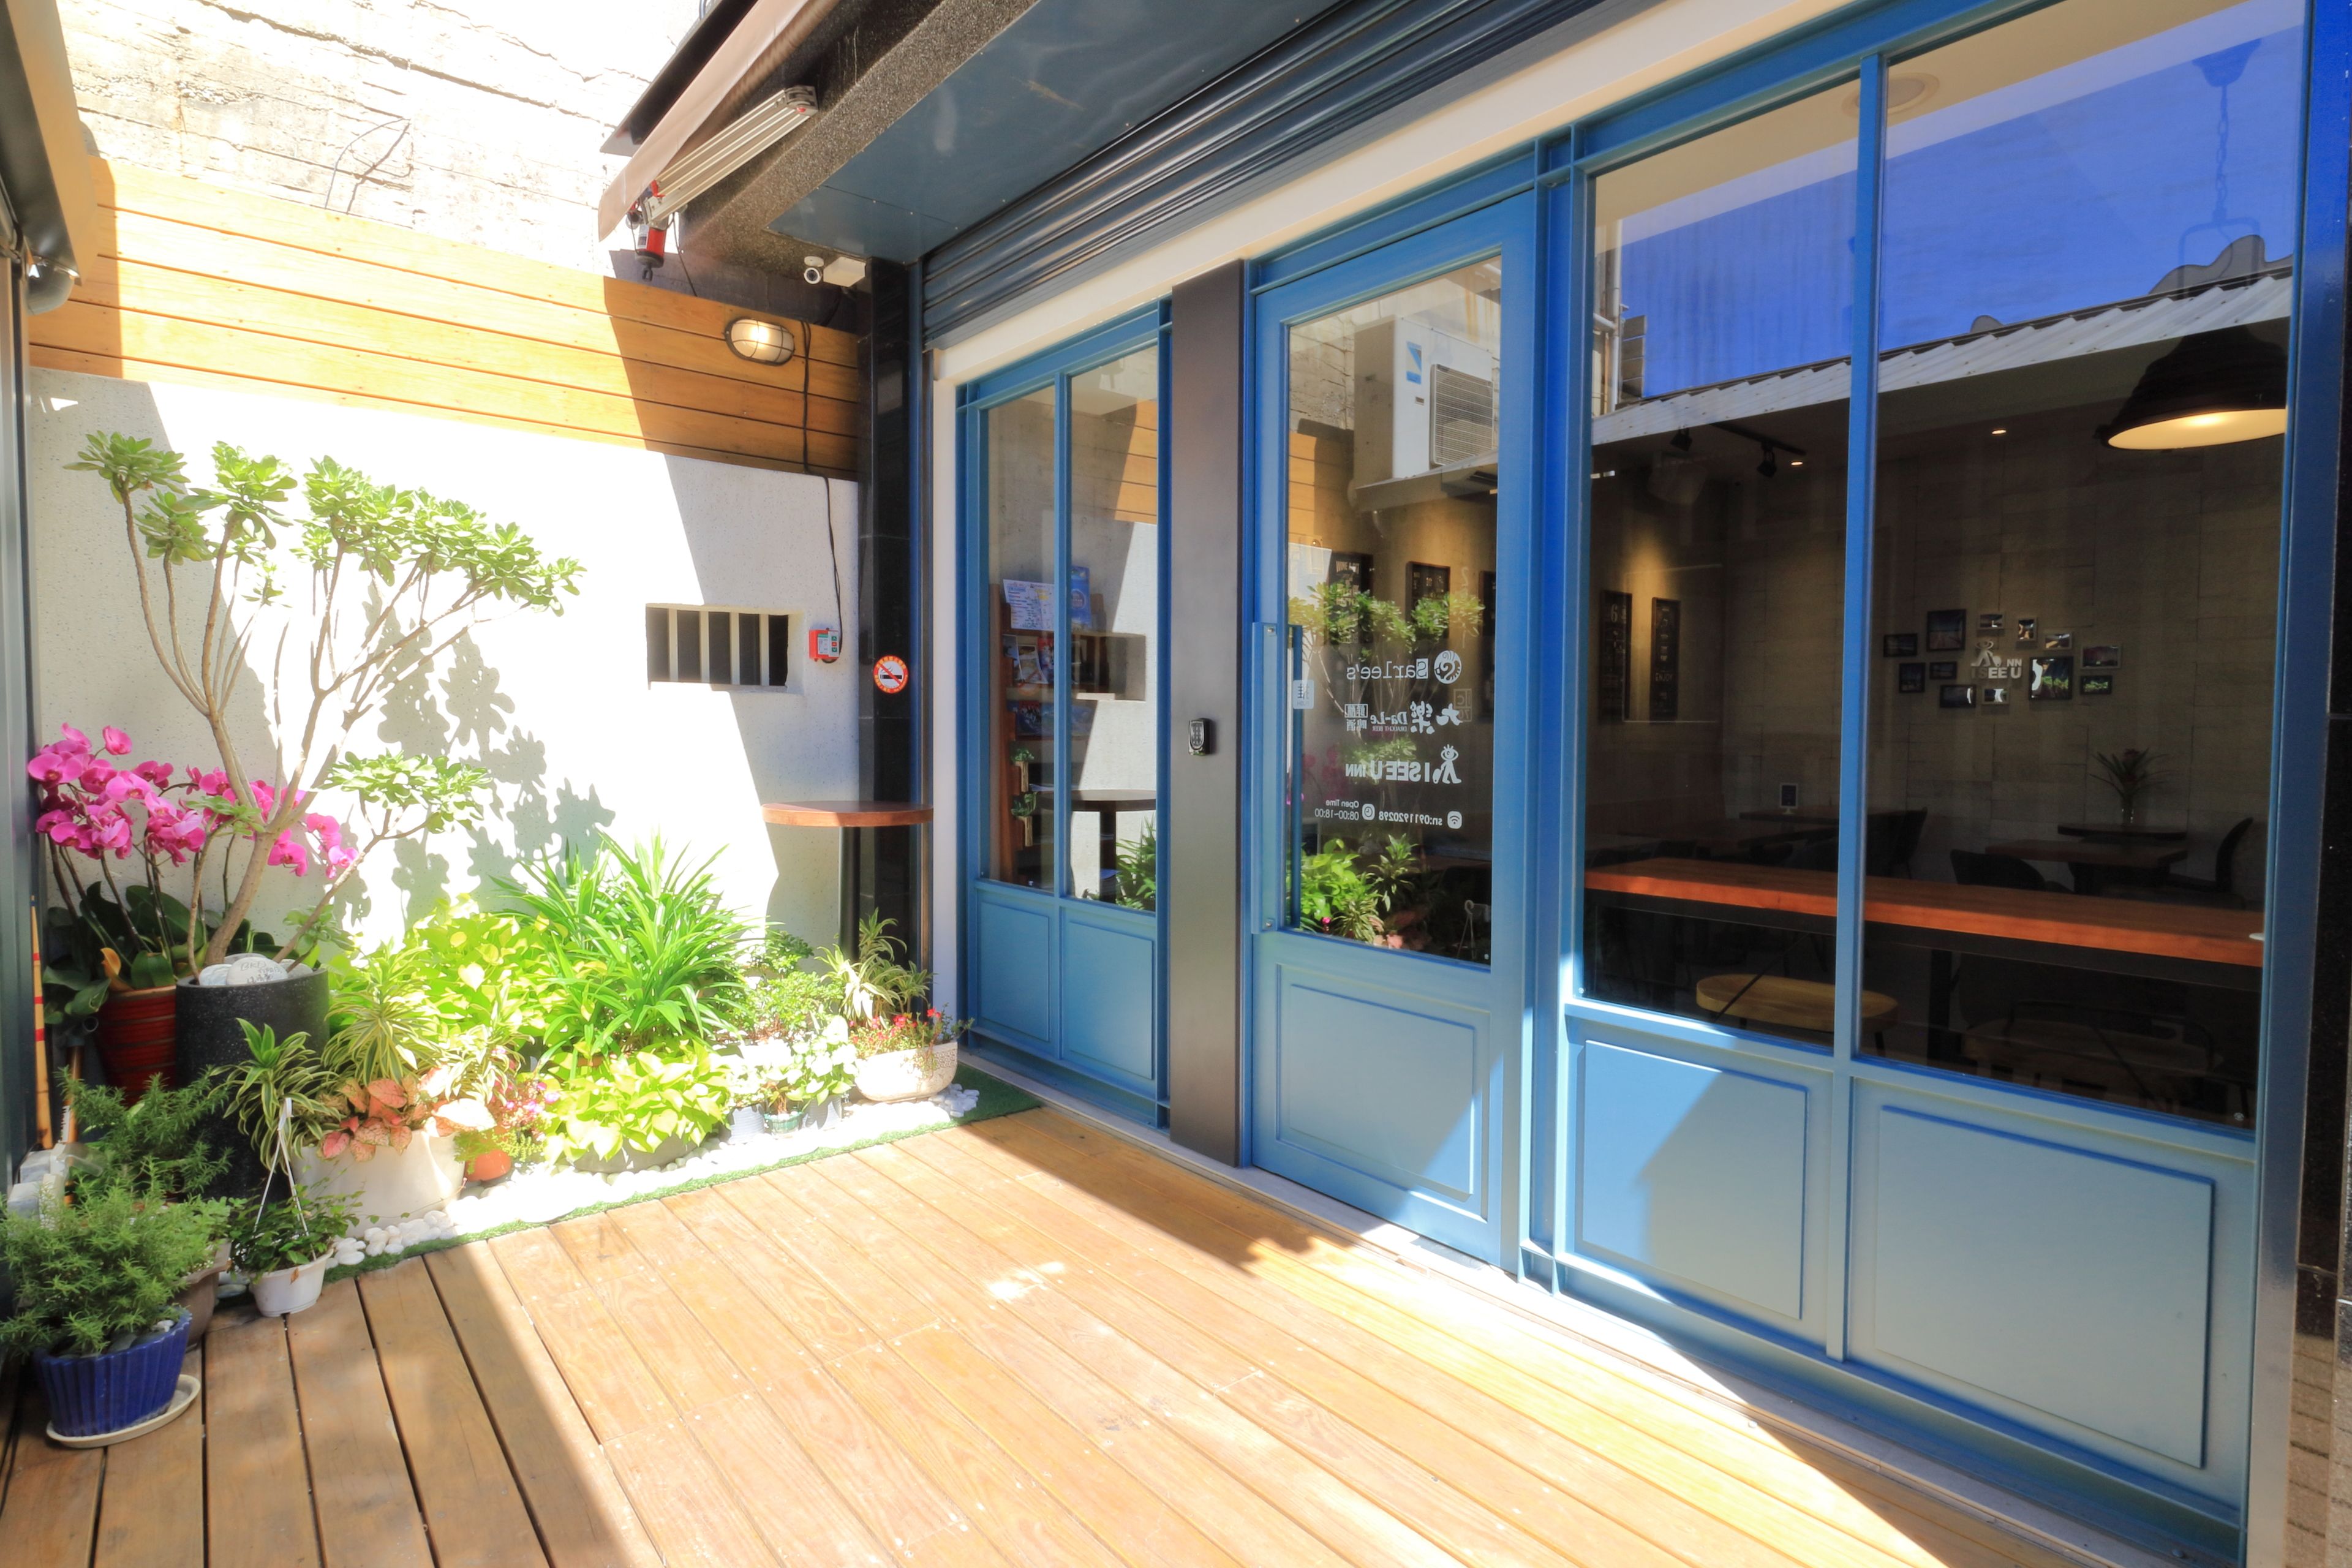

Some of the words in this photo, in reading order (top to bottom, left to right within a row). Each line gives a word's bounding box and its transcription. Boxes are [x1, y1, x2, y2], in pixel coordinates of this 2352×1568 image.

[2003, 658, 2022, 667] NN
[1978, 667, 2008, 679] SEE
[2010, 667, 2022, 679] U
